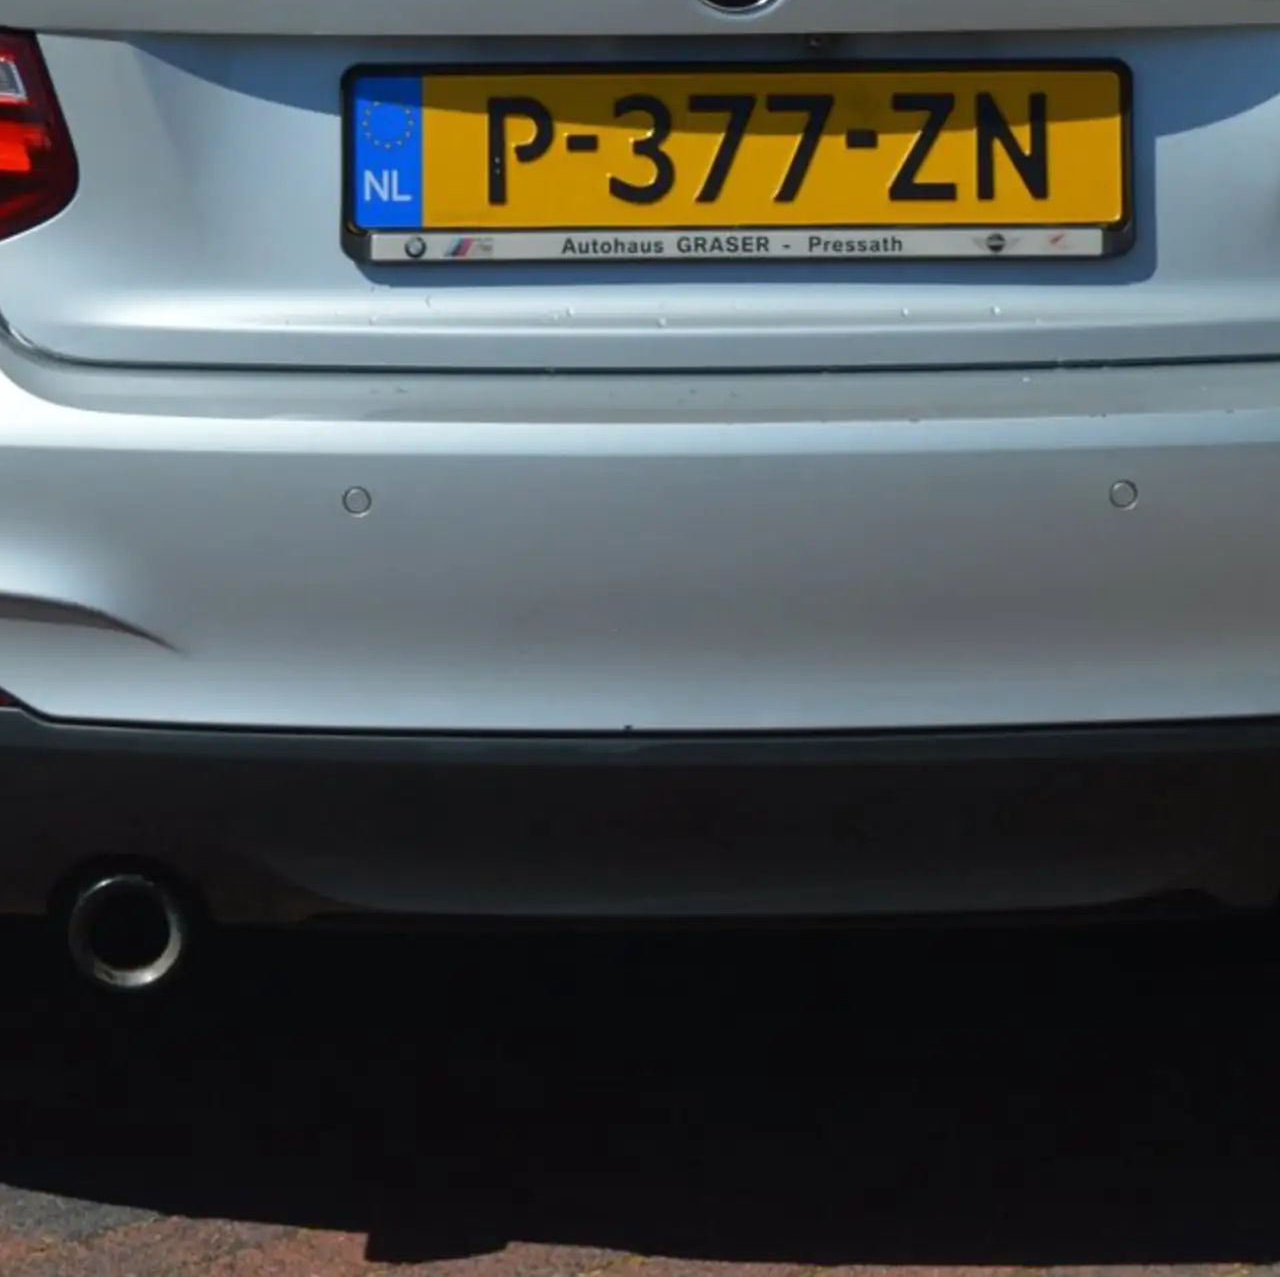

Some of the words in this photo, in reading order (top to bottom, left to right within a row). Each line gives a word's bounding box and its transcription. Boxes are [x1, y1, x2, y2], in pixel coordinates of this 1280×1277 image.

[487, 93, 1049, 206] P-377-ZN
[364, 169, 413, 202] NL
[561, 237, 665, 255] Autohaus
[676, 236, 770, 254] GRASER
[808, 235, 903, 253] Pressath
